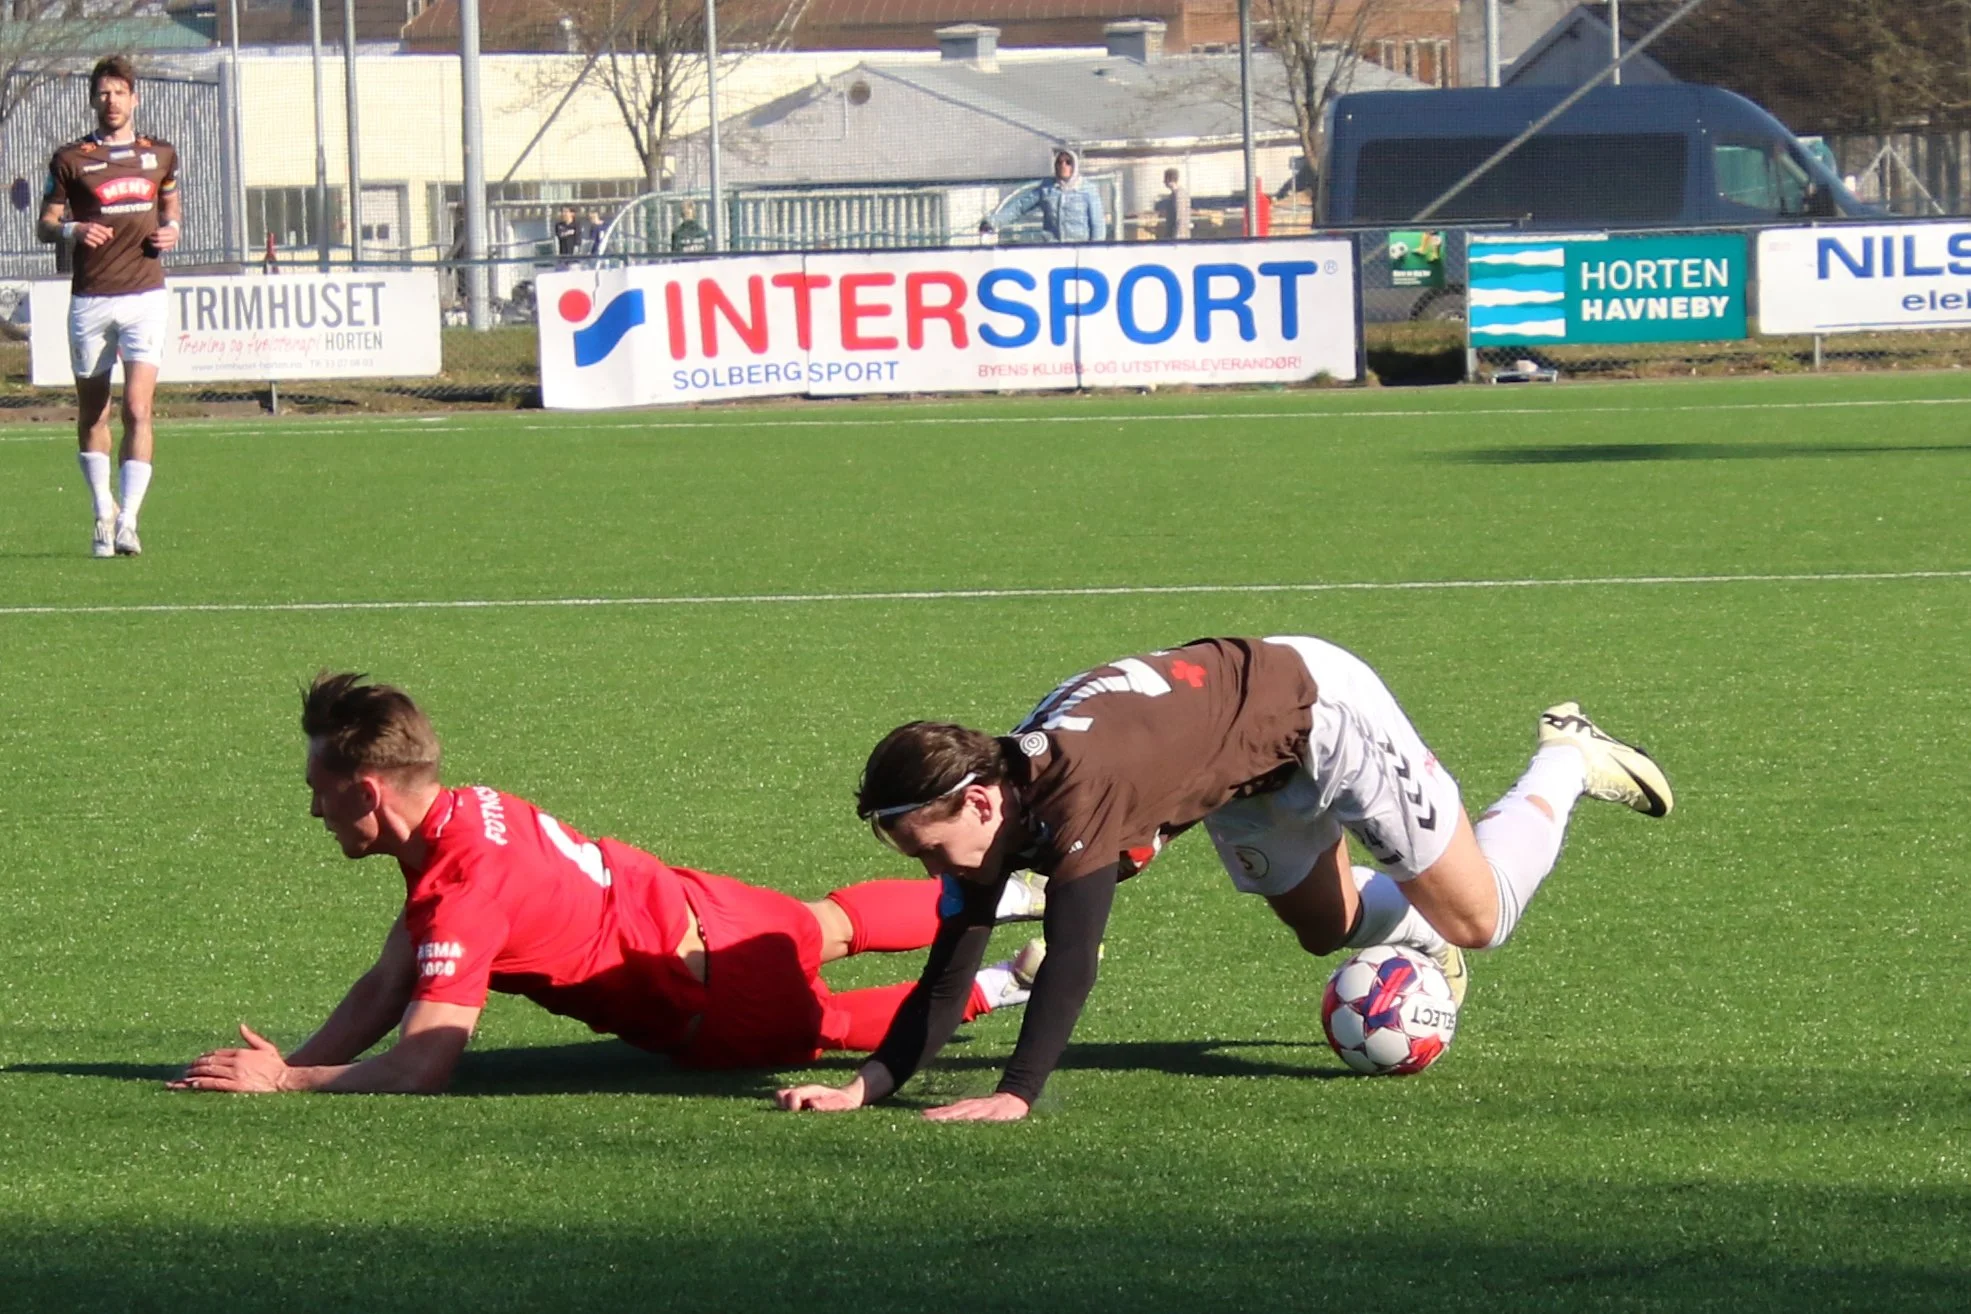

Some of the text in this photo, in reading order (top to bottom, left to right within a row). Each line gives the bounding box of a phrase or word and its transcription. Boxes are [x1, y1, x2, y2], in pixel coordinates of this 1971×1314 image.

[103, 180, 151, 199] MENY
[1581, 258, 1729, 291] HORTEN
[173, 281, 386, 331] TRIMHUSET
[665, 260, 1318, 360] INTERSPORT
[1581, 296, 1730, 321] HAVNEBY
[1902, 289, 1971, 311] ele
[325, 331, 383, 351] HORTEN
[673, 361, 899, 390] SOLBERG SPORT
[978, 363, 1028, 377] BYENS
[1094, 360, 1117, 373] OG
